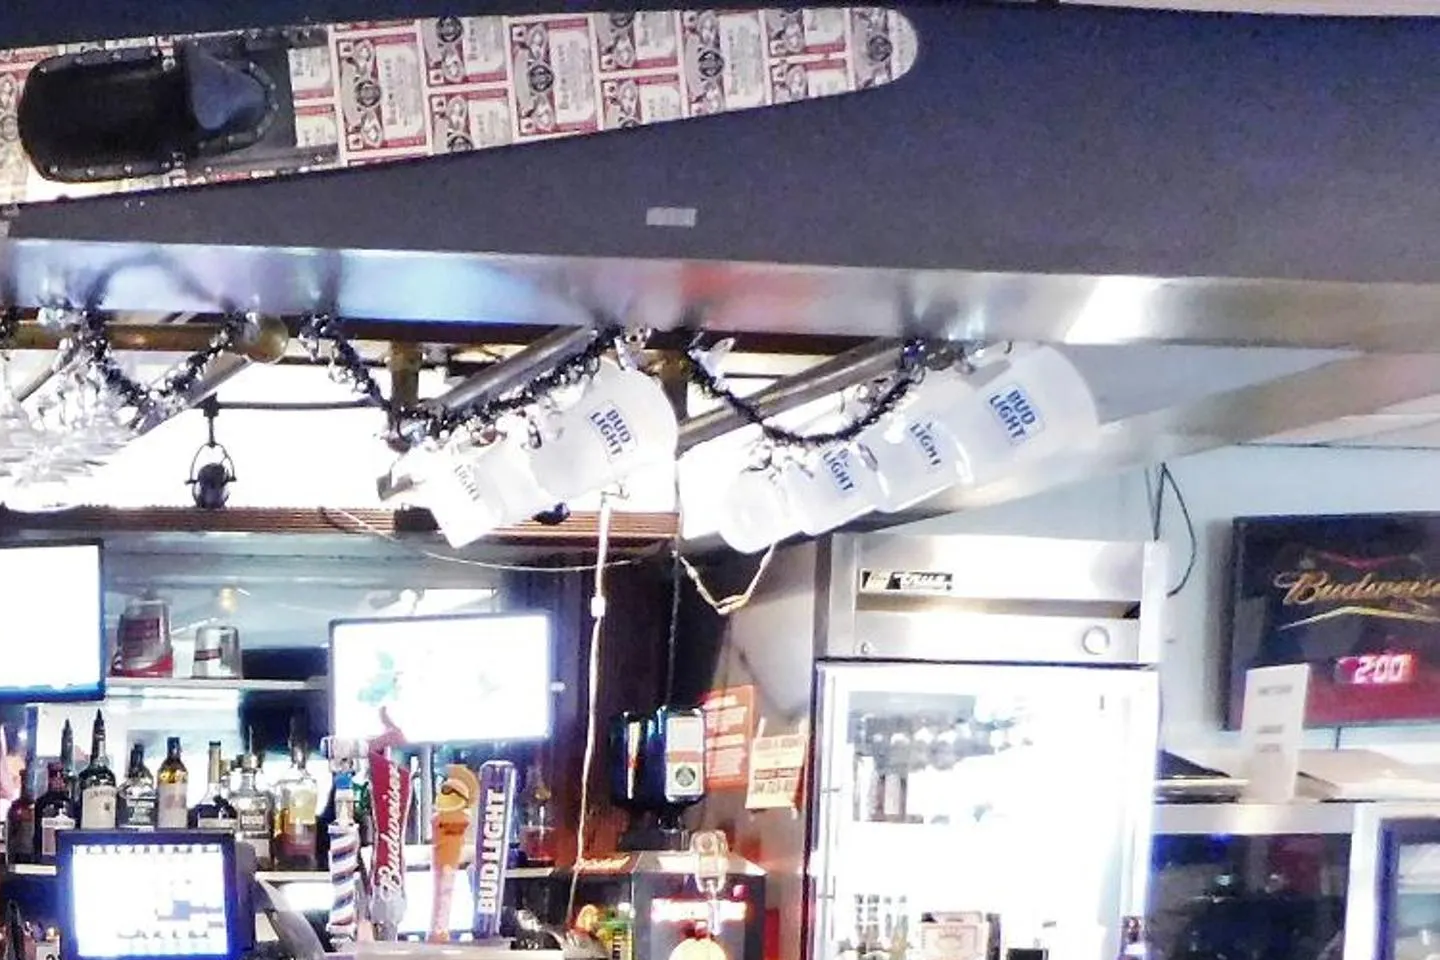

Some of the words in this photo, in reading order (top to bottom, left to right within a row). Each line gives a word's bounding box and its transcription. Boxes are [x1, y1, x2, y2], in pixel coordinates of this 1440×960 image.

[606, 409, 632, 444] BUD
[988, 394, 1027, 440] LIGHT
[1007, 389, 1037, 426] BUD
[590, 412, 623, 456] LIGHT
[910, 422, 942, 467] LIGHT
[822, 450, 854, 492] LIGHT
[377, 762, 402, 901] Budweiser
[481, 788, 506, 861] LIGHT
[478, 862, 500, 914] BUD
